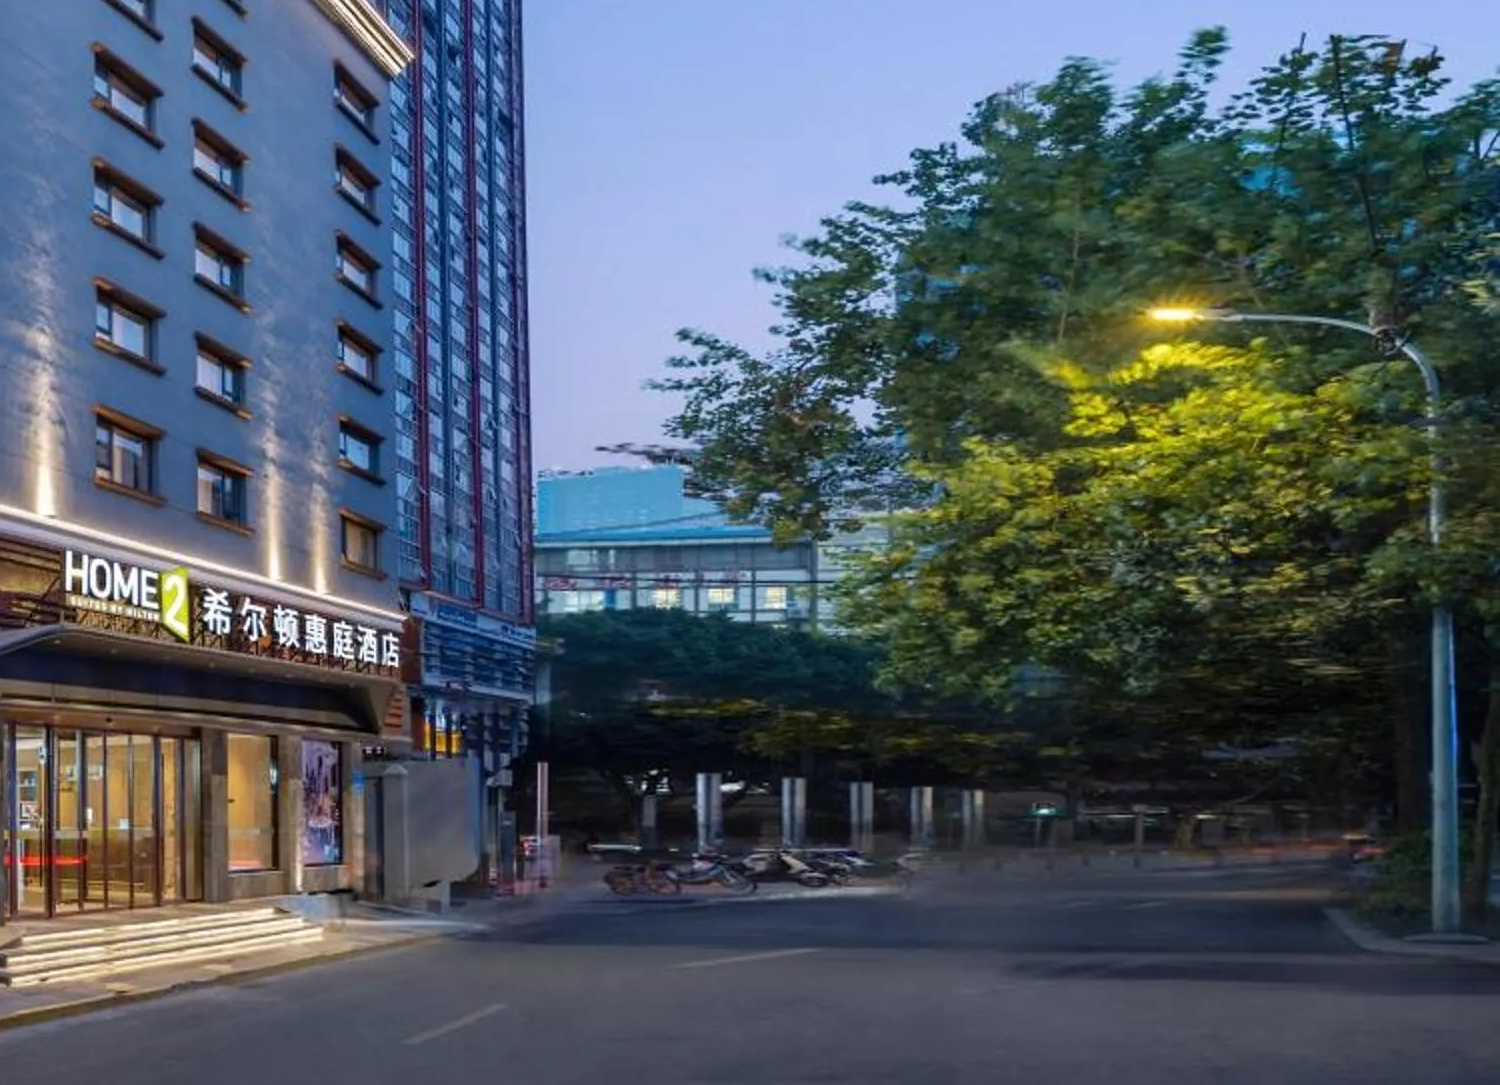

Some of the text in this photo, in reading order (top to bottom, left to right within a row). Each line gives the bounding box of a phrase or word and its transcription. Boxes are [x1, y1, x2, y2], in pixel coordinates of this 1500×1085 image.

[203, 588, 400, 668] 希尔顿惠庭酒店
